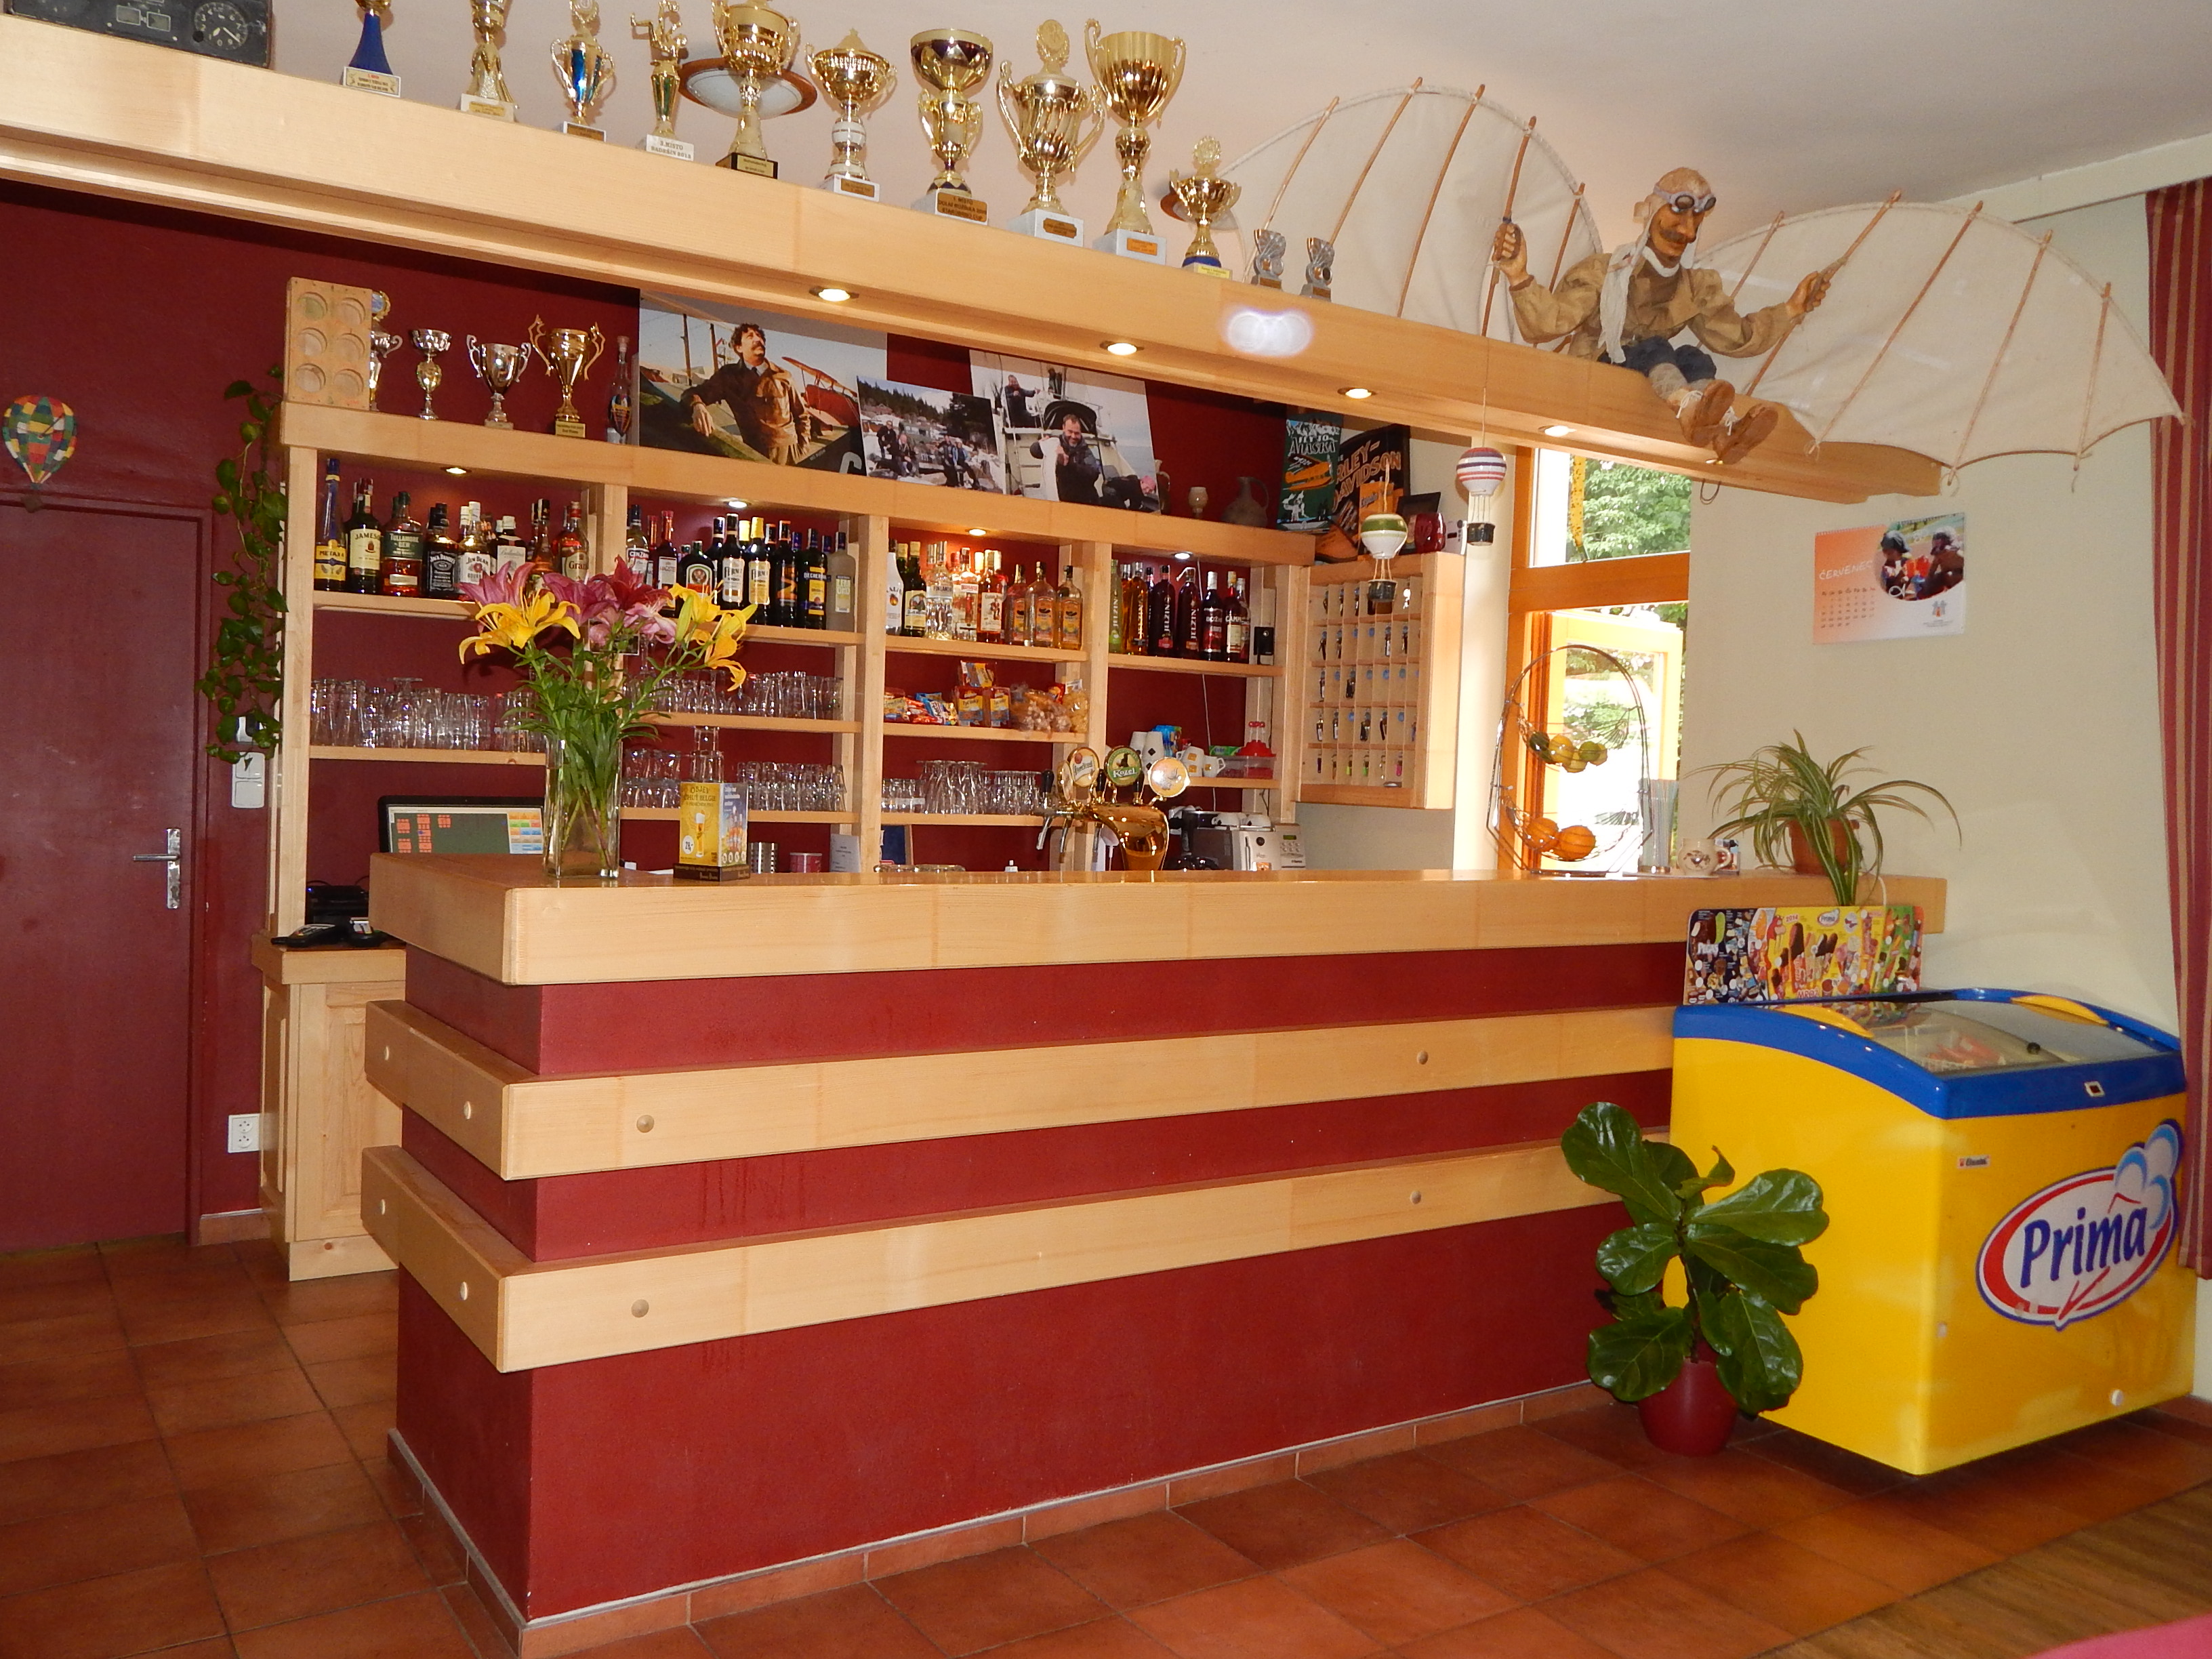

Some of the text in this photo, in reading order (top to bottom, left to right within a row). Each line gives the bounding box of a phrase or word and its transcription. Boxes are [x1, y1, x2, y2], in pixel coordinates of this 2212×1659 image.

[1288, 436, 1336, 457] ALASKA
[1113, 768, 1136, 778] Kozel
[2020, 1206, 2148, 1289] Prima
